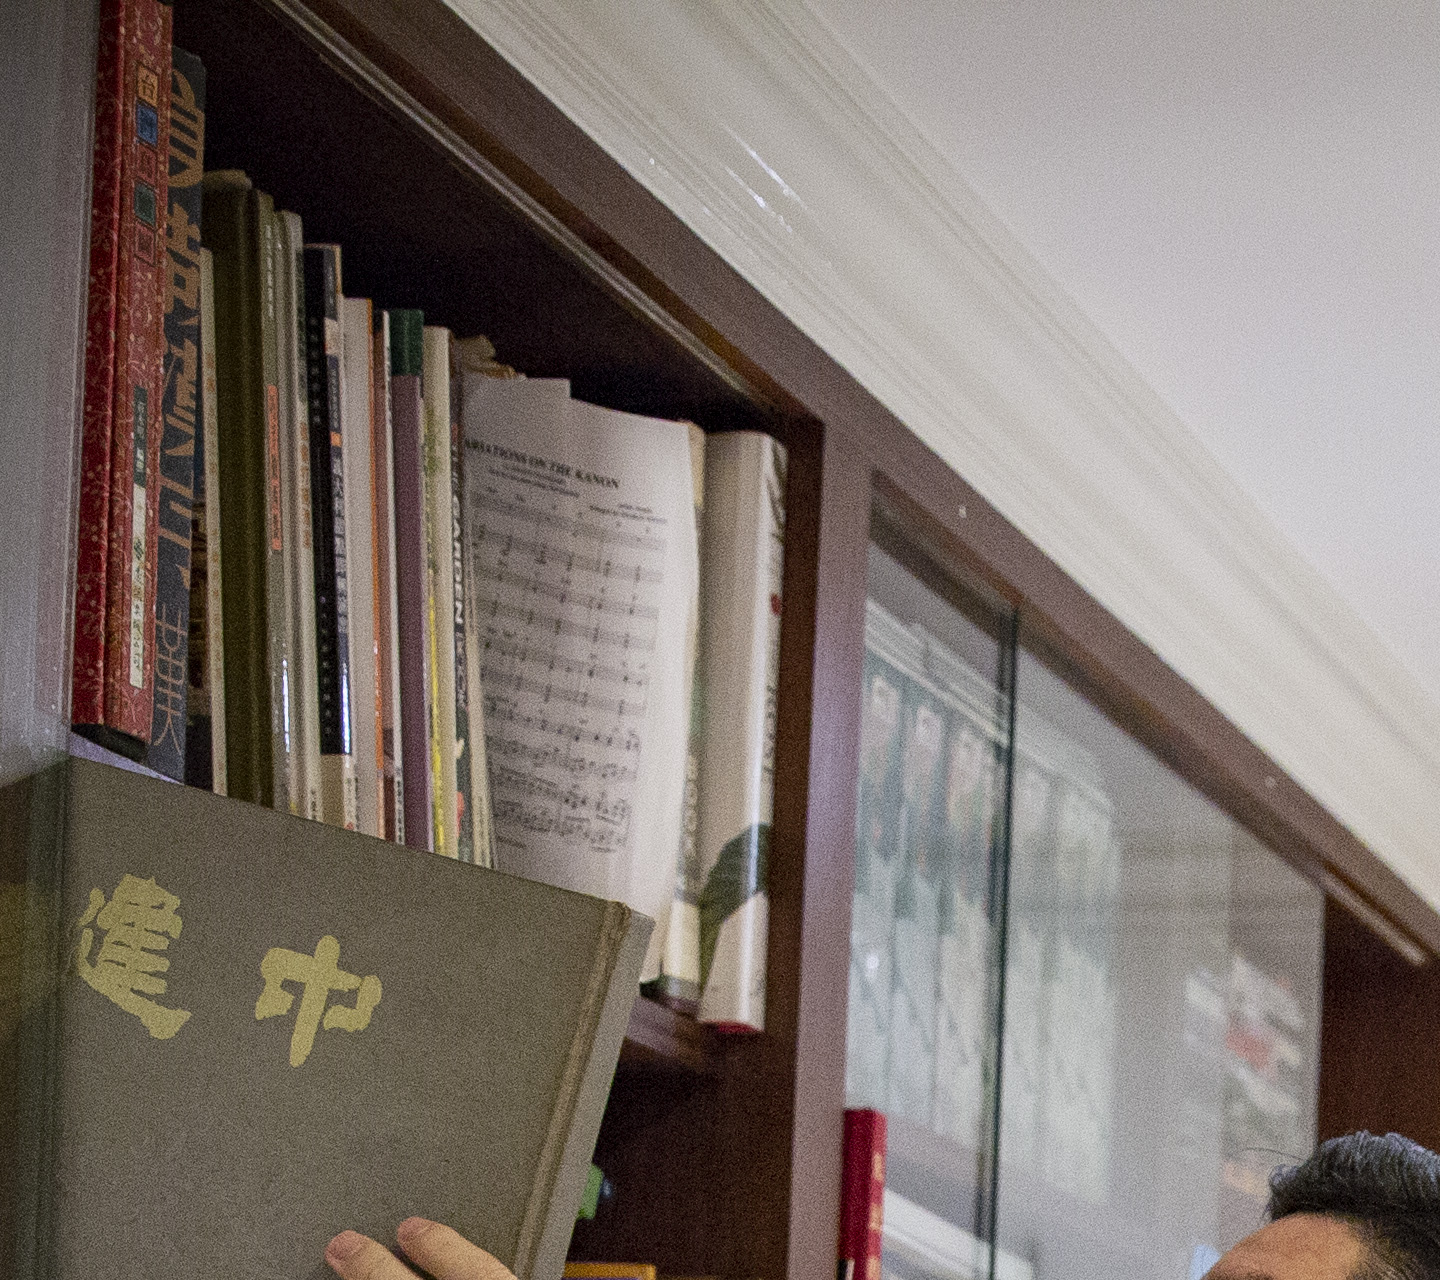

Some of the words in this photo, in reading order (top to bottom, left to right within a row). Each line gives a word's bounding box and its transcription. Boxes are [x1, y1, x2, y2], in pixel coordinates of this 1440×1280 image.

[549, 461, 572, 477] THE
[575, 468, 619, 488] KANON
[450, 492, 469, 626] GARDEN
